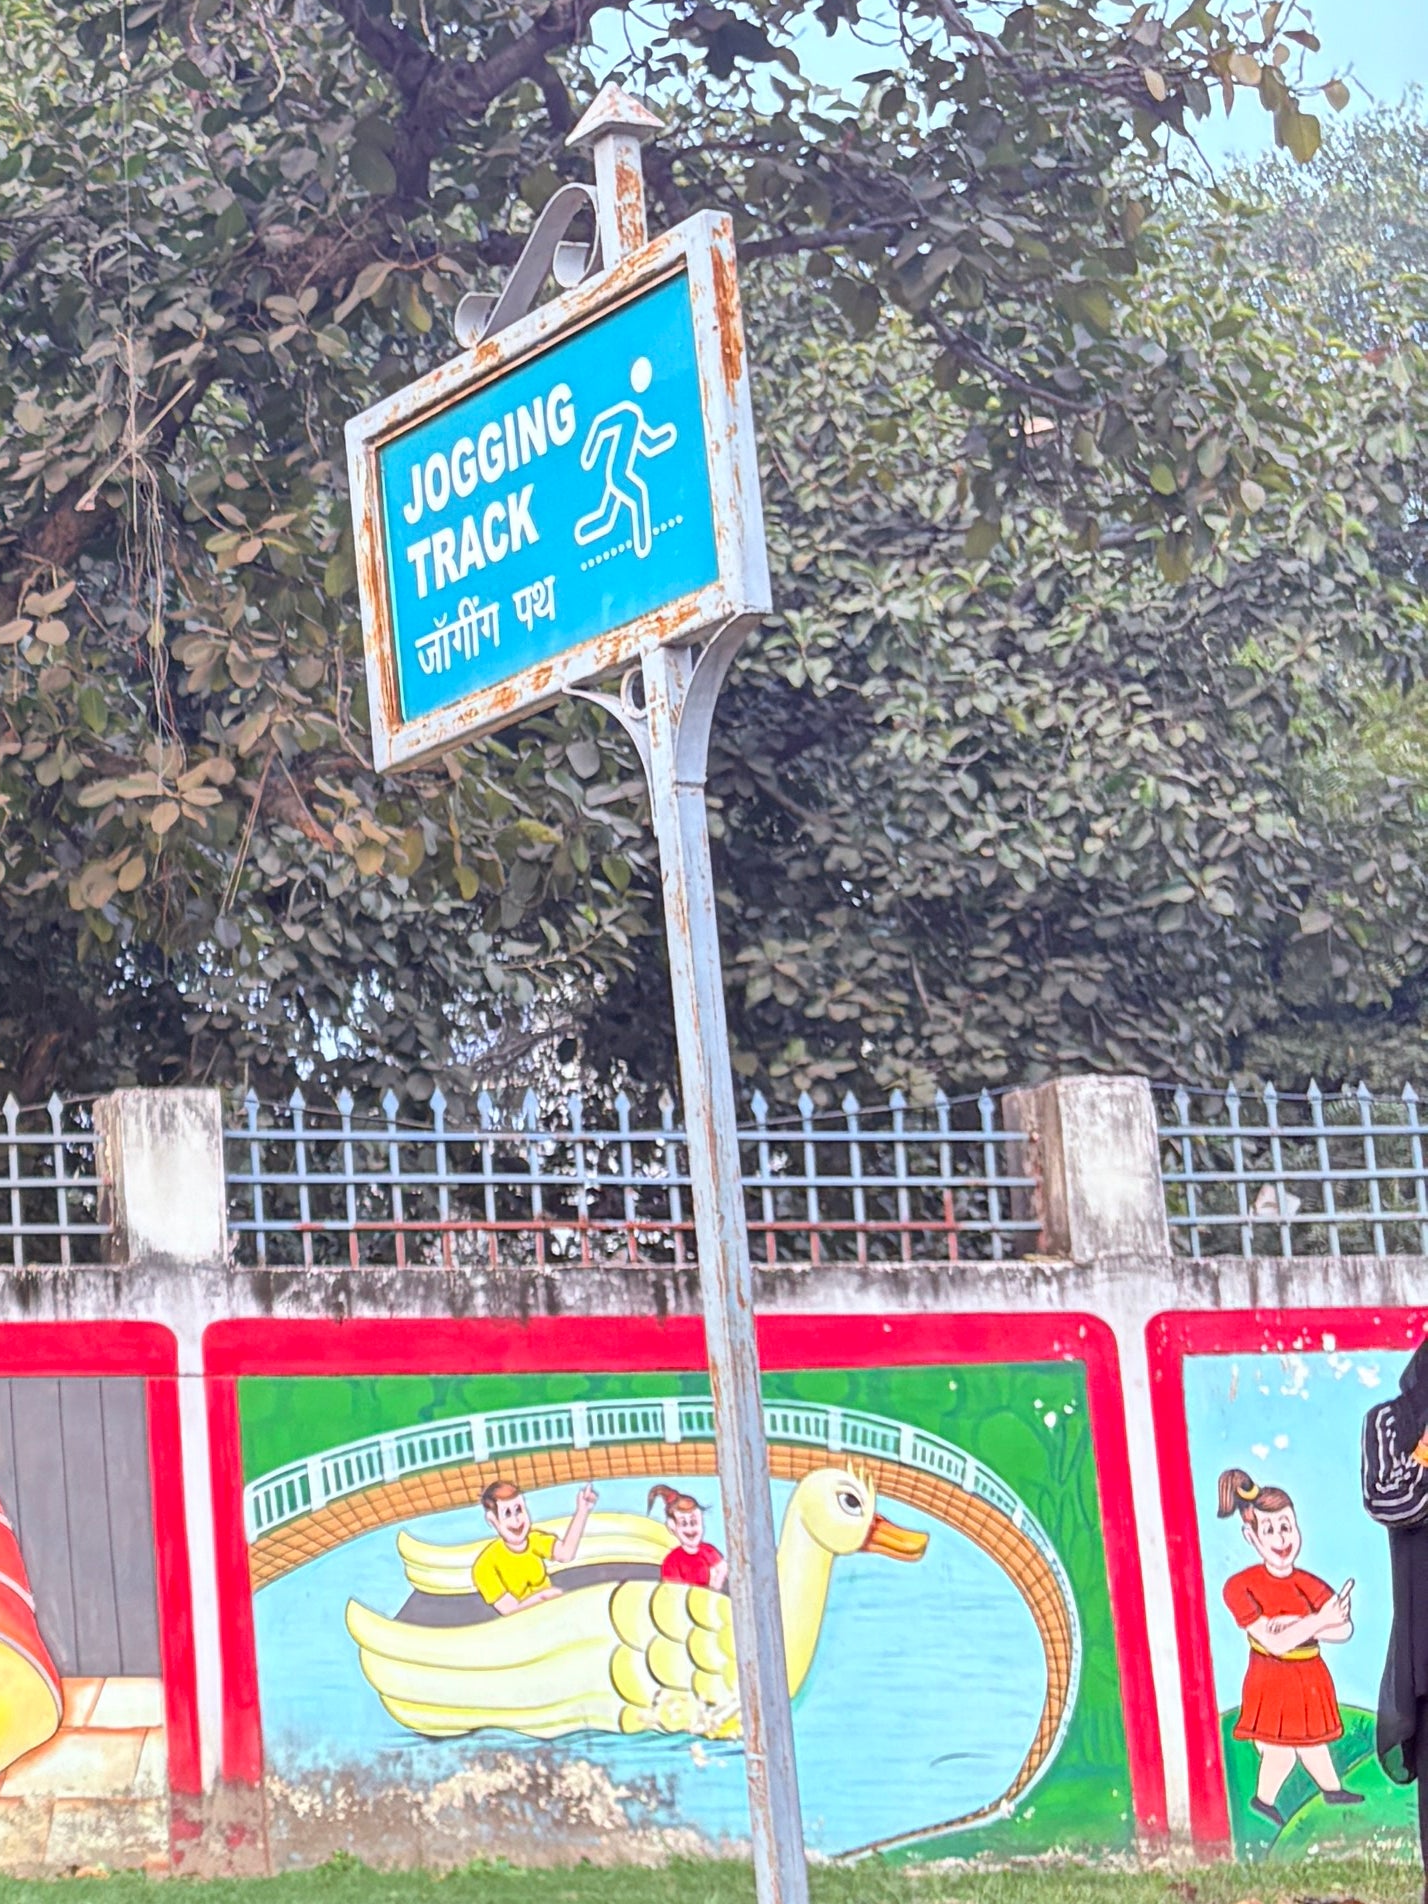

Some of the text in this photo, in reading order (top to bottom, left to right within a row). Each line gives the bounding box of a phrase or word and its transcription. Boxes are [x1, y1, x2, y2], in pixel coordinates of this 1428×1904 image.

[403, 382, 576, 525] JOGGING
[406, 484, 540, 599] TRACK
[414, 575, 556, 675] जॉगींग पथ
